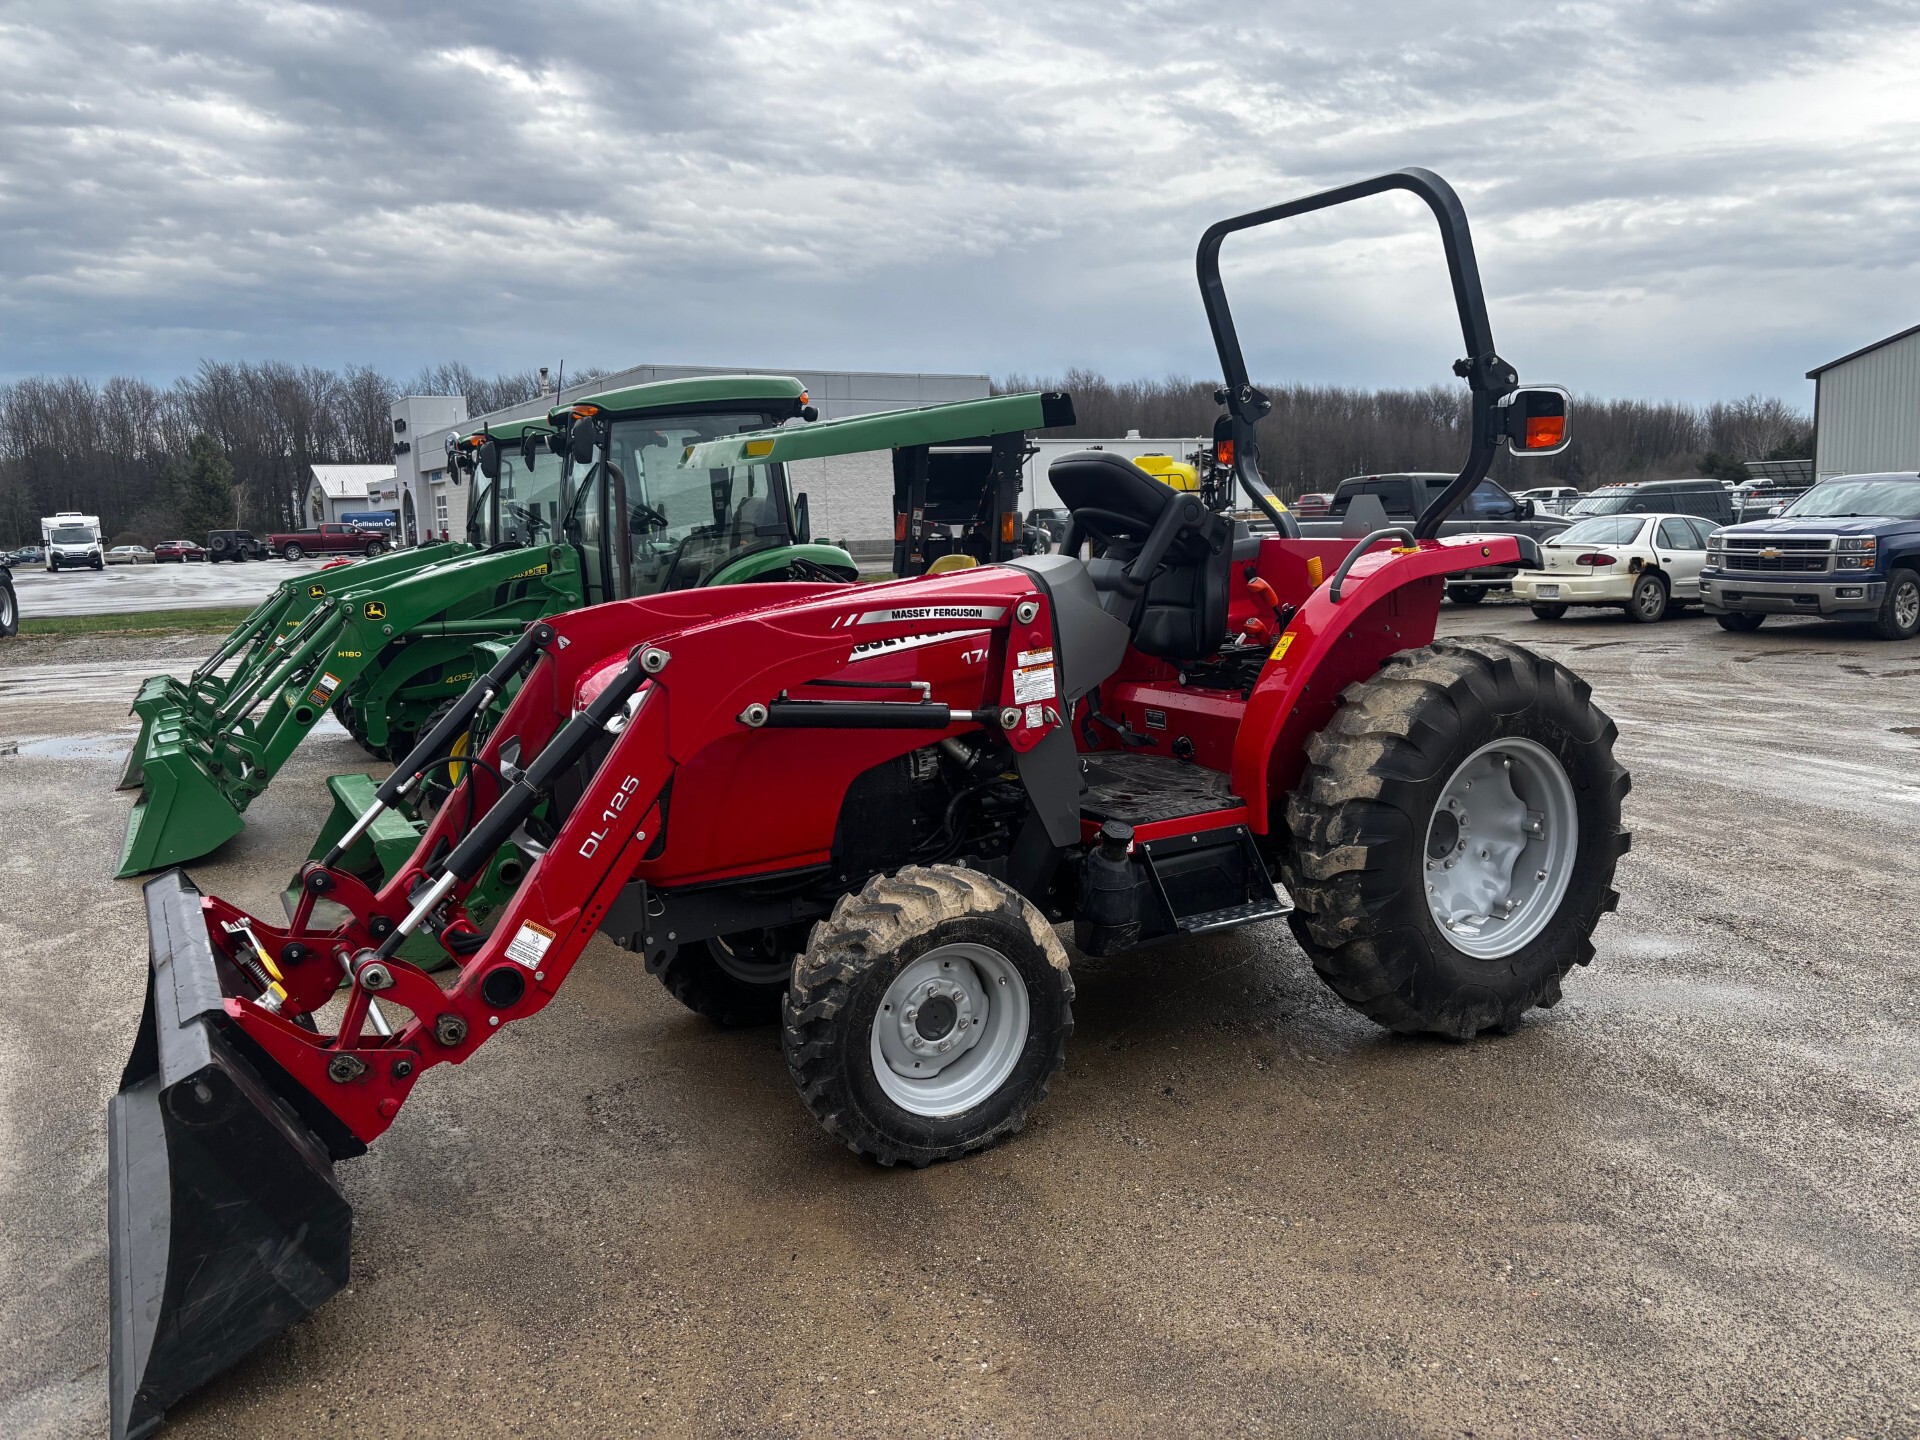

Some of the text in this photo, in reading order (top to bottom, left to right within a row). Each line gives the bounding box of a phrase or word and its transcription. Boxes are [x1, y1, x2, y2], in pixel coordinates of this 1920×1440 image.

[352, 519, 383, 527] Collision
[891, 608, 983, 620] MASSEY FERGUSON
[445, 672, 474, 684] 4052
